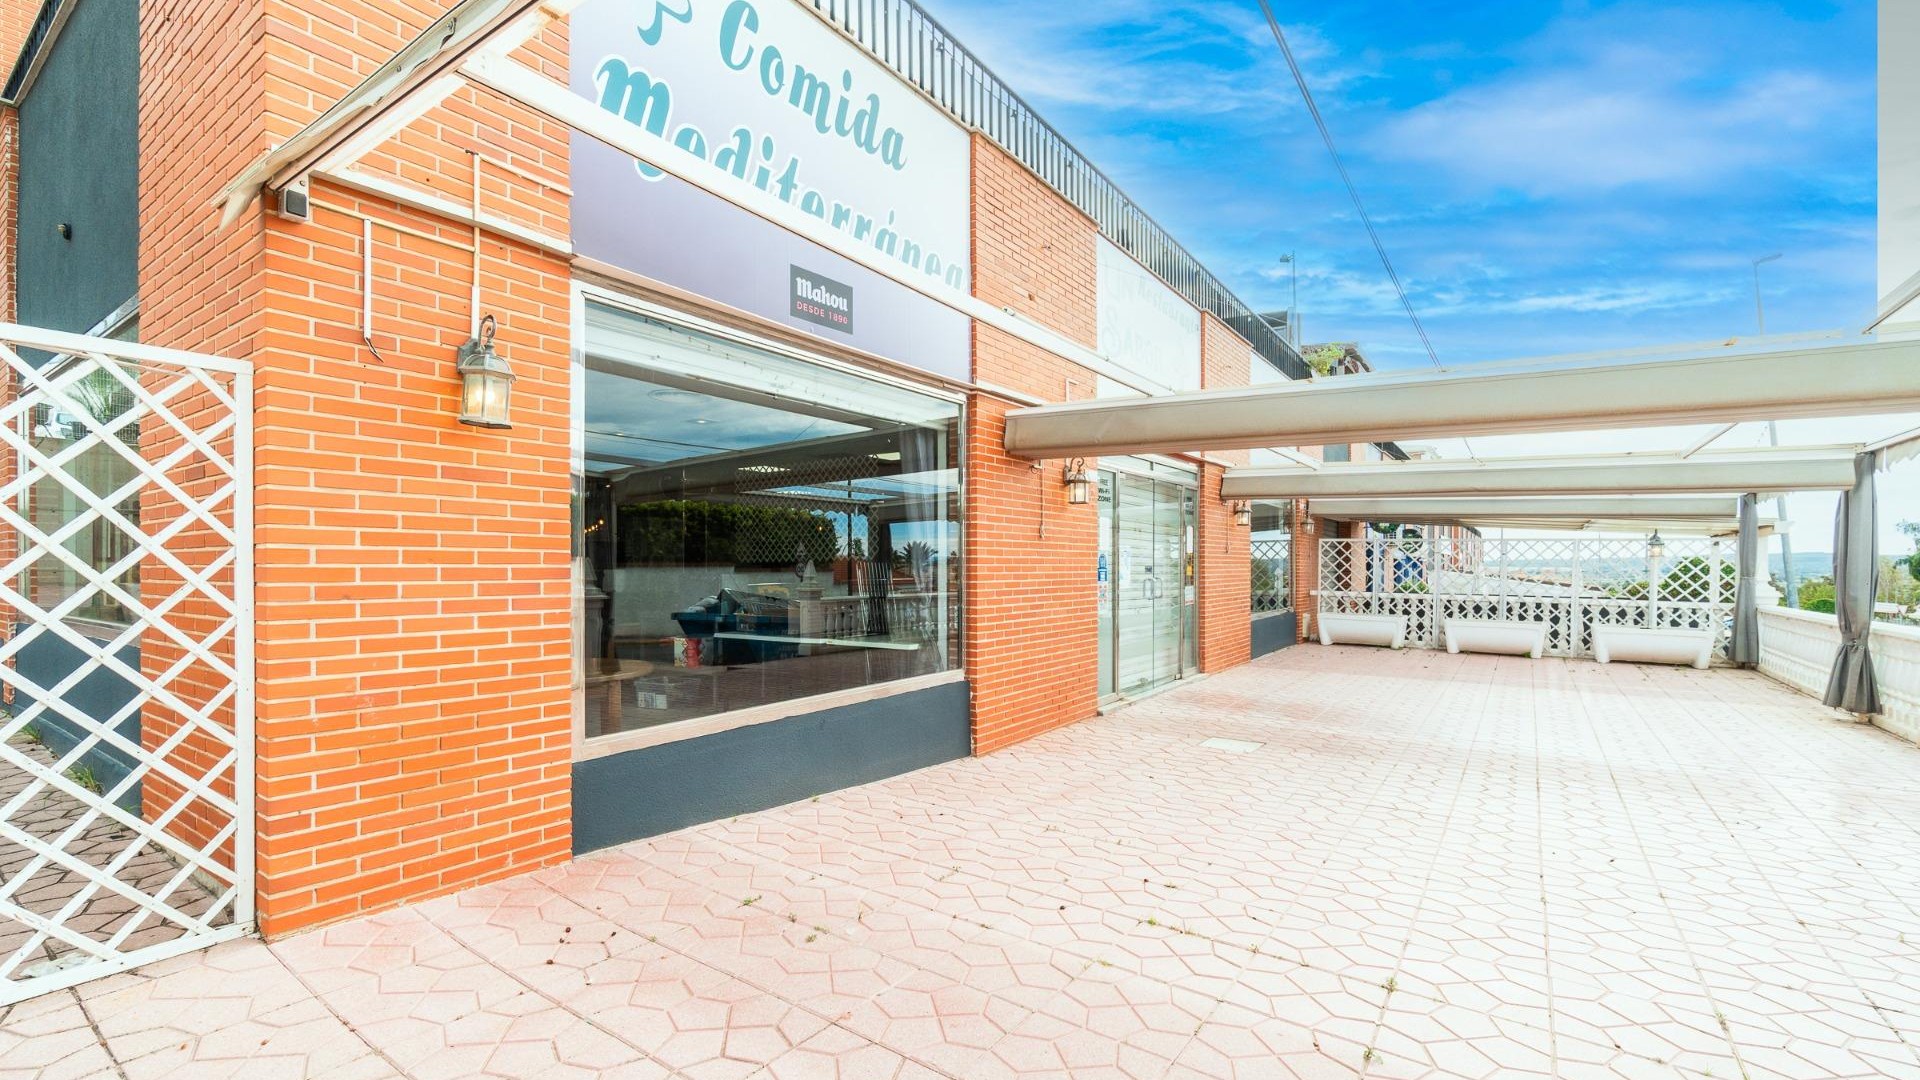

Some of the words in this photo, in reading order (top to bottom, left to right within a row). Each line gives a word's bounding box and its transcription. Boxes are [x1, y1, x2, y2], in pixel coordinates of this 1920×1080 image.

[719, 0, 908, 172] Comida
[796, 277, 849, 312] Mahou
[796, 301, 825, 318] DESDE
[829, 311, 849, 325] 1890
